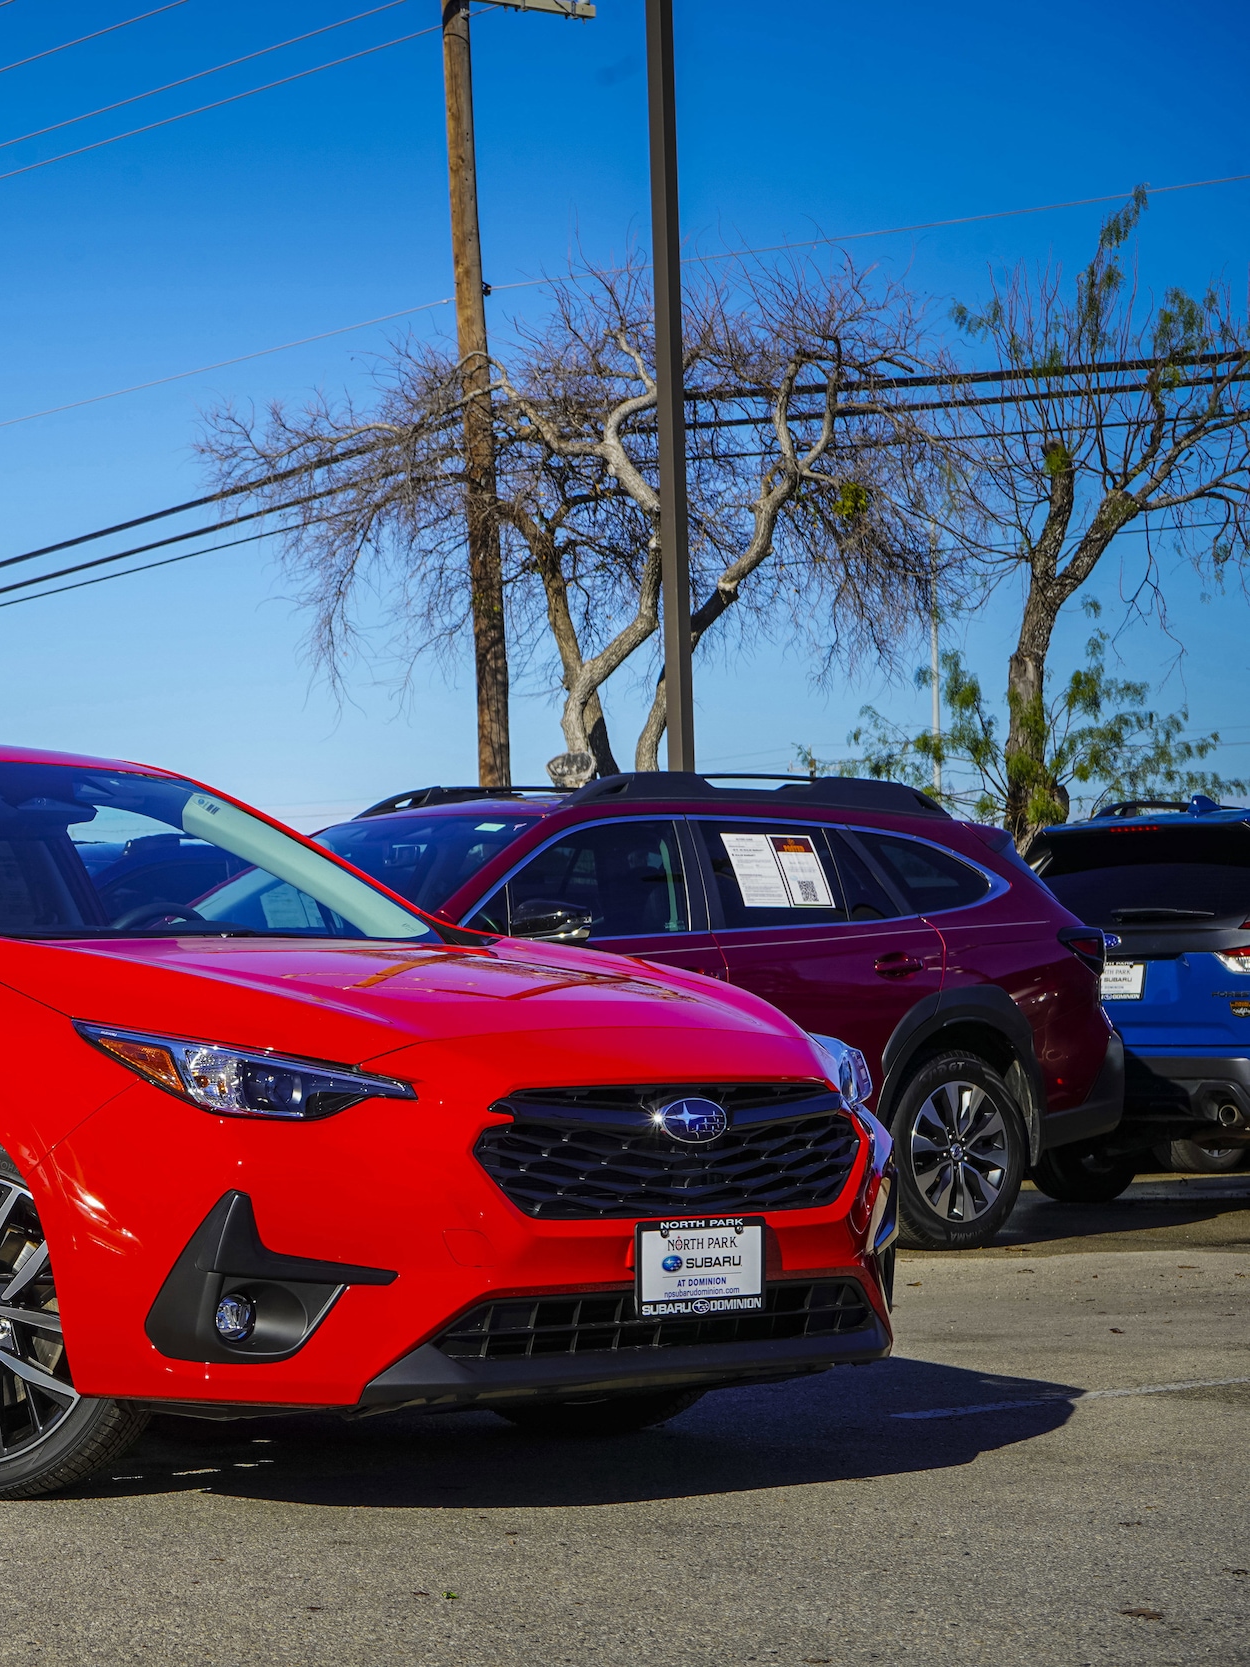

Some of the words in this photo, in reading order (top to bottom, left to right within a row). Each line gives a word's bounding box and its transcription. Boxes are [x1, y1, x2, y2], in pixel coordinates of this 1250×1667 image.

[948, 1061, 965, 1071] GT
[660, 1220, 705, 1230] NORTH
[709, 1218, 744, 1227] PARK
[667, 1236, 704, 1251] NORTH
[707, 1236, 739, 1249] PARK
[685, 1255, 742, 1269] SUBARU
[676, 1279, 686, 1288] AT
[688, 1277, 727, 1287] DOMINION
[664, 1286, 740, 1299] npsubarudominion.com
[641, 1302, 692, 1316] SUBARU
[710, 1297, 762, 1311] DOMINION
